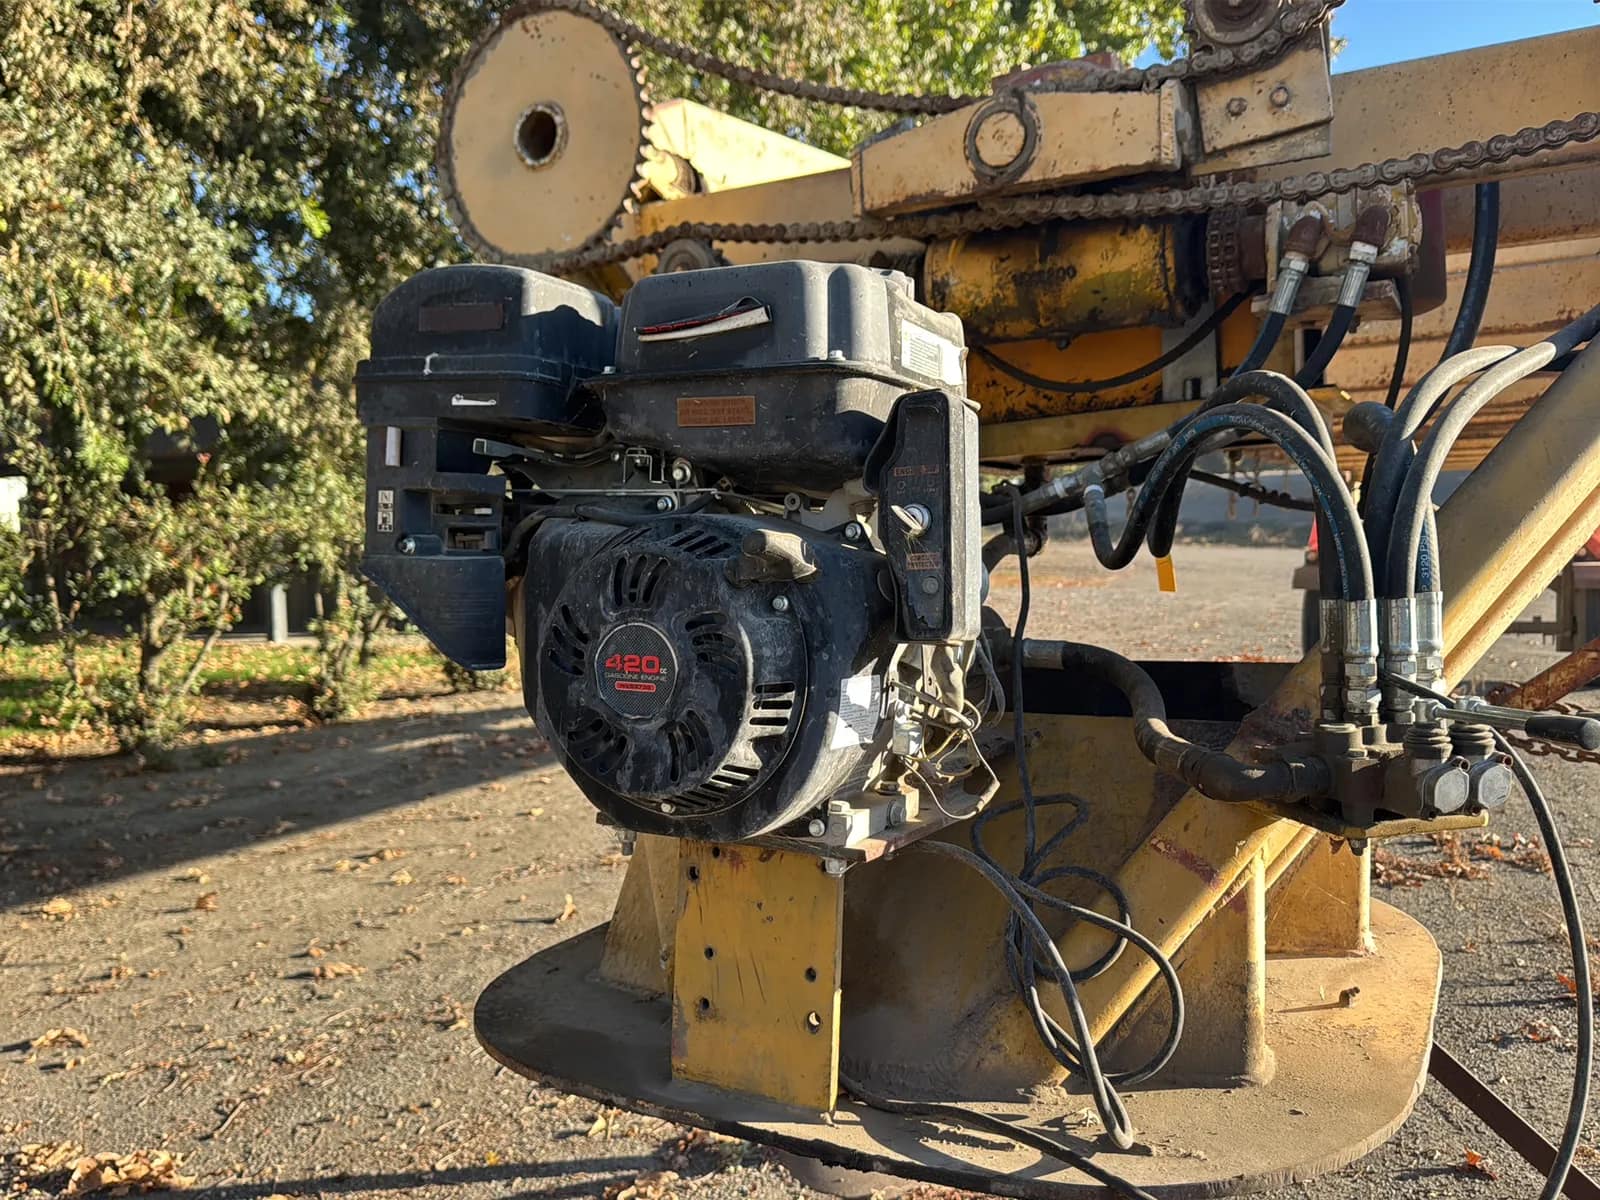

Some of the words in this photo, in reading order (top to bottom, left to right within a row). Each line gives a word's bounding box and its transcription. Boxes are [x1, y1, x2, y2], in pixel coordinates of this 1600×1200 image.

[1420, 535, 1428, 551] PSI
[1420, 554, 1429, 578] 3120
[605, 654, 660, 673] 420
